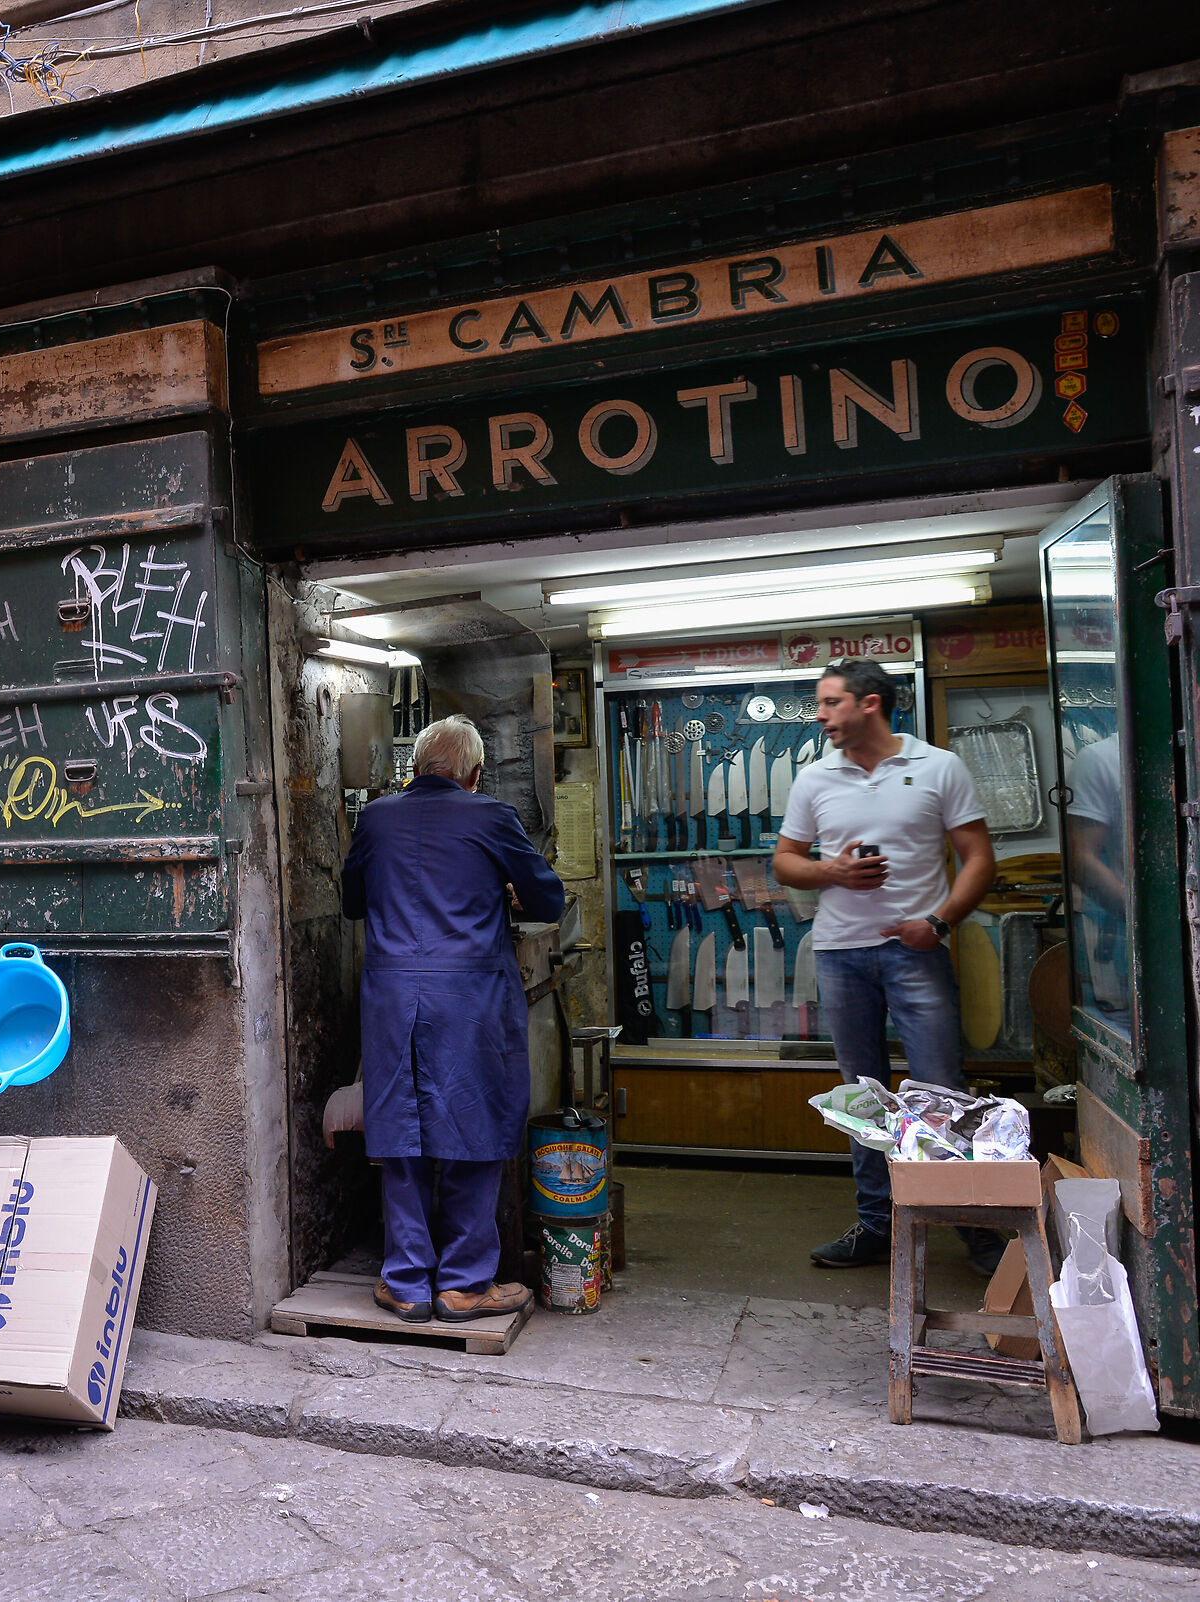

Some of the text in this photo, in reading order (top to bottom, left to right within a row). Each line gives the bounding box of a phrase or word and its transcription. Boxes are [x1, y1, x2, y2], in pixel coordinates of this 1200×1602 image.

[448, 234, 925, 352] CAMBRIA
[321, 346, 1043, 513] ARROTINO
[828, 633, 912, 658] Bufalo
[992, 628, 1047, 650] Bufa
[711, 644, 769, 661] DICK
[628, 940, 650, 999] Bufalo
[537, 1144, 600, 1157] ACCIUGHE SALATE
[553, 1194, 588, 1203] COALMA
[96, 1245, 127, 1360] inblu
